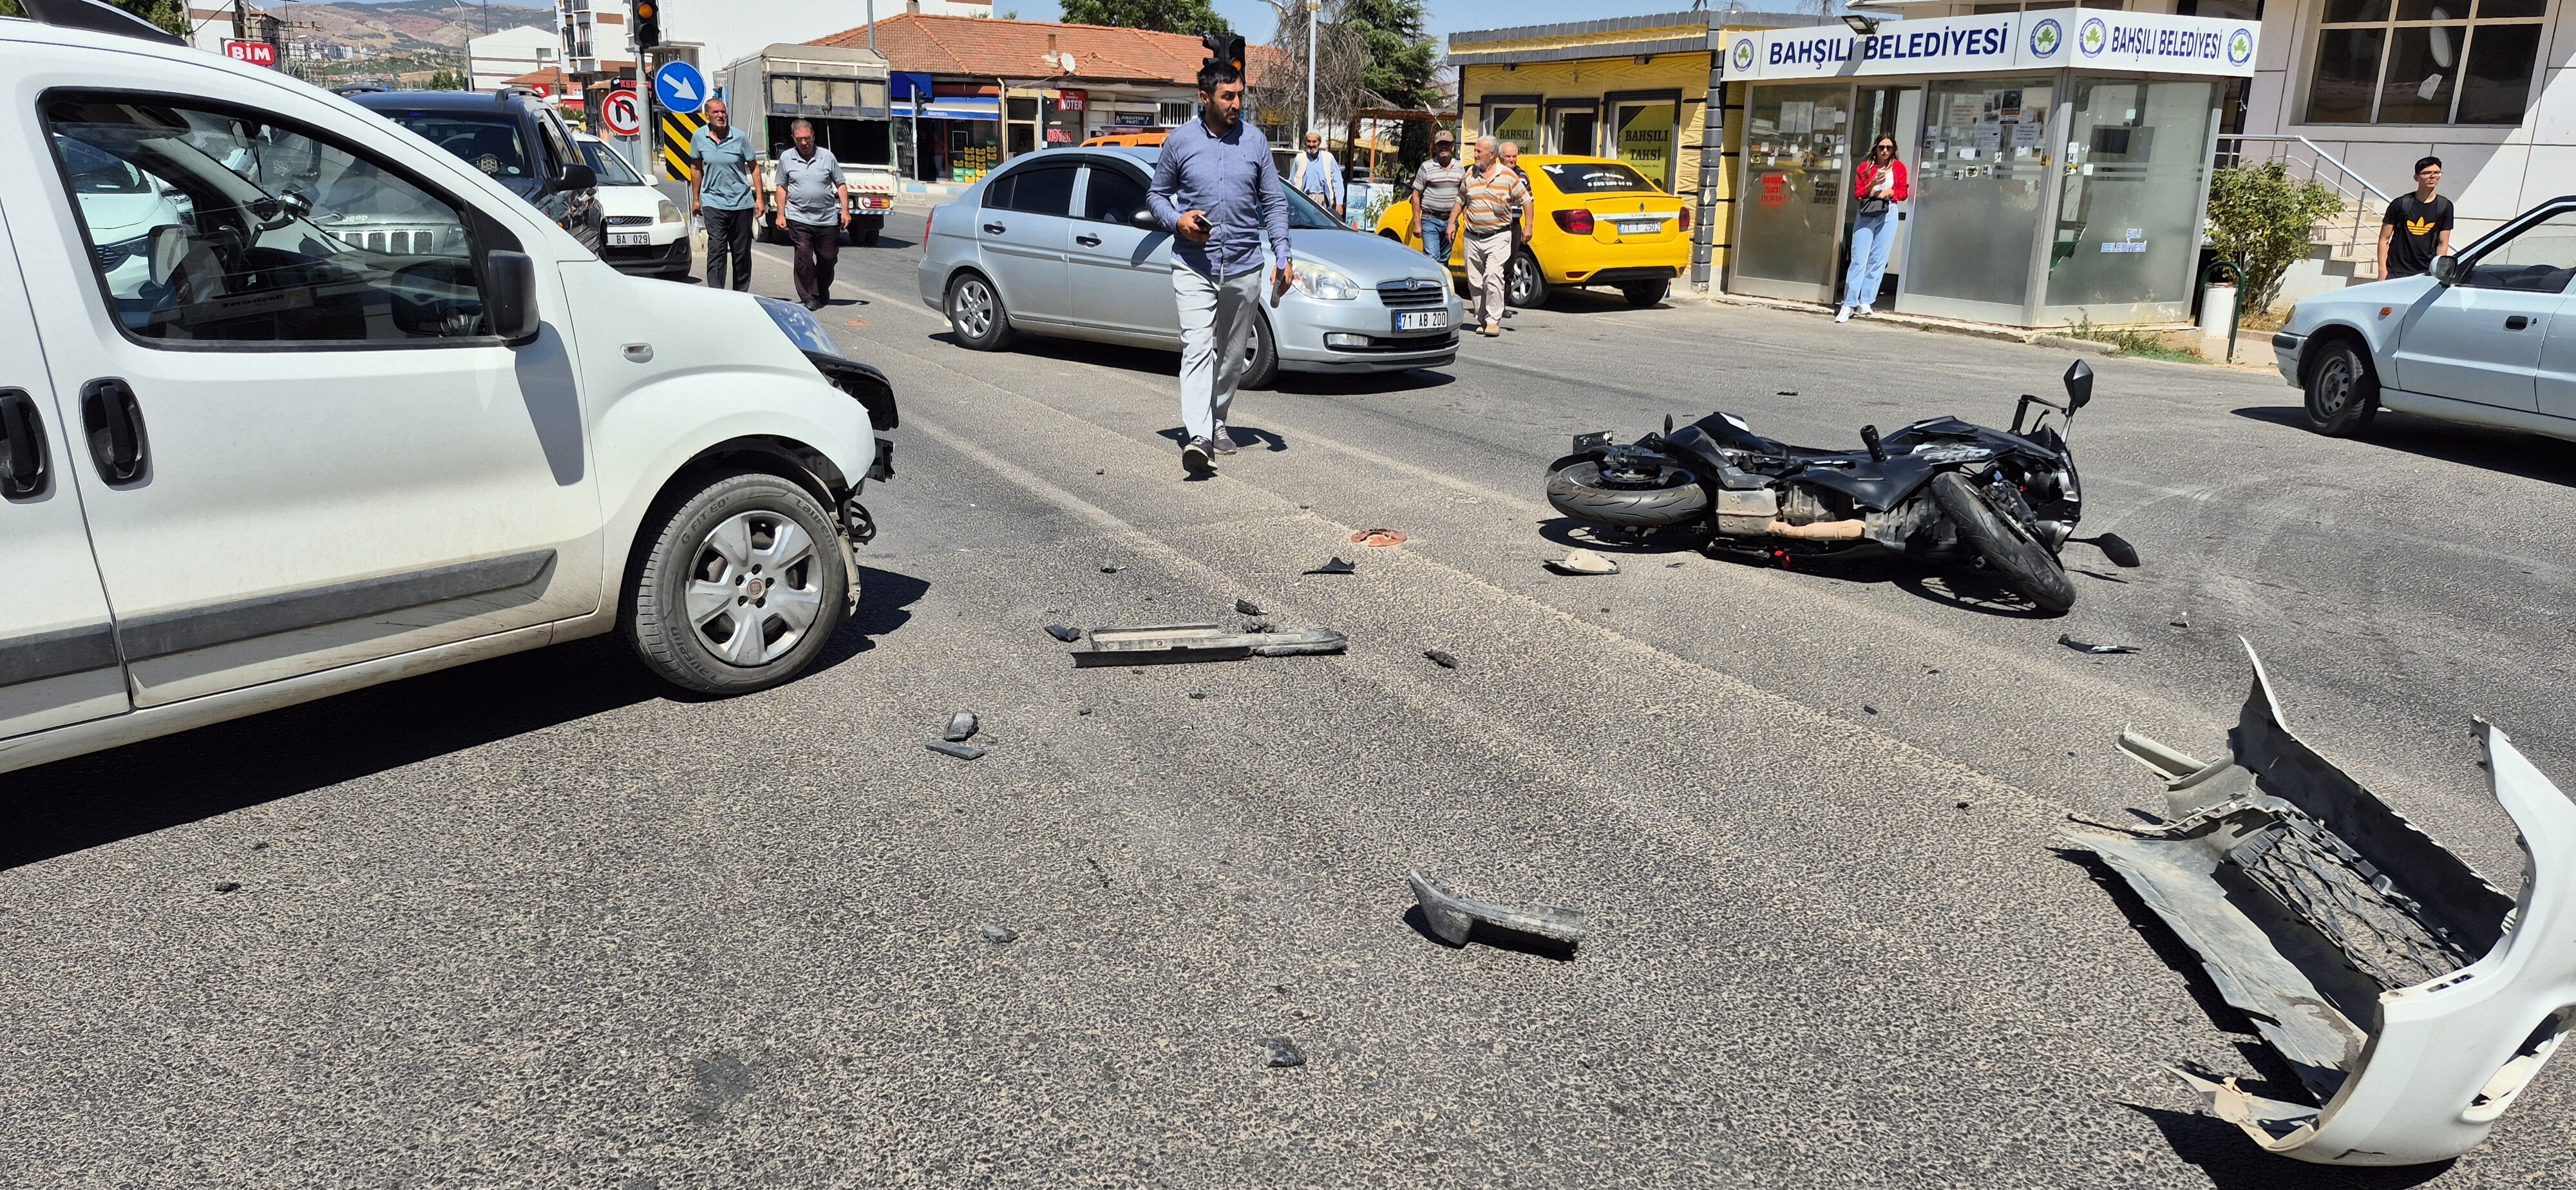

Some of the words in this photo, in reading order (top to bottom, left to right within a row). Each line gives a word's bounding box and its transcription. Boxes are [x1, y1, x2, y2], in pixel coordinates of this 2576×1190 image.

[231, 43, 271, 61] BİM
[1769, 37, 1855, 70] BAHŞILI
[1864, 22, 2009, 60] BELEDİYESİ
[2111, 26, 2157, 62] BAHŞILI
[2158, 27, 2223, 59] BELEDİYESİ
[1061, 99, 1083, 111] NOTER
[1046, 129, 1072, 142] NOTER
[1625, 129, 1669, 145] BAHŞILI
[1629, 147, 1662, 161] TAKSİ
[616, 235, 627, 245] BA
[633, 234, 648, 243] 029
[1402, 314, 1412, 328] 71
[1419, 313, 1428, 328] AB
[1432, 312, 1446, 326] 200
[690, 511, 710, 532] FIT
